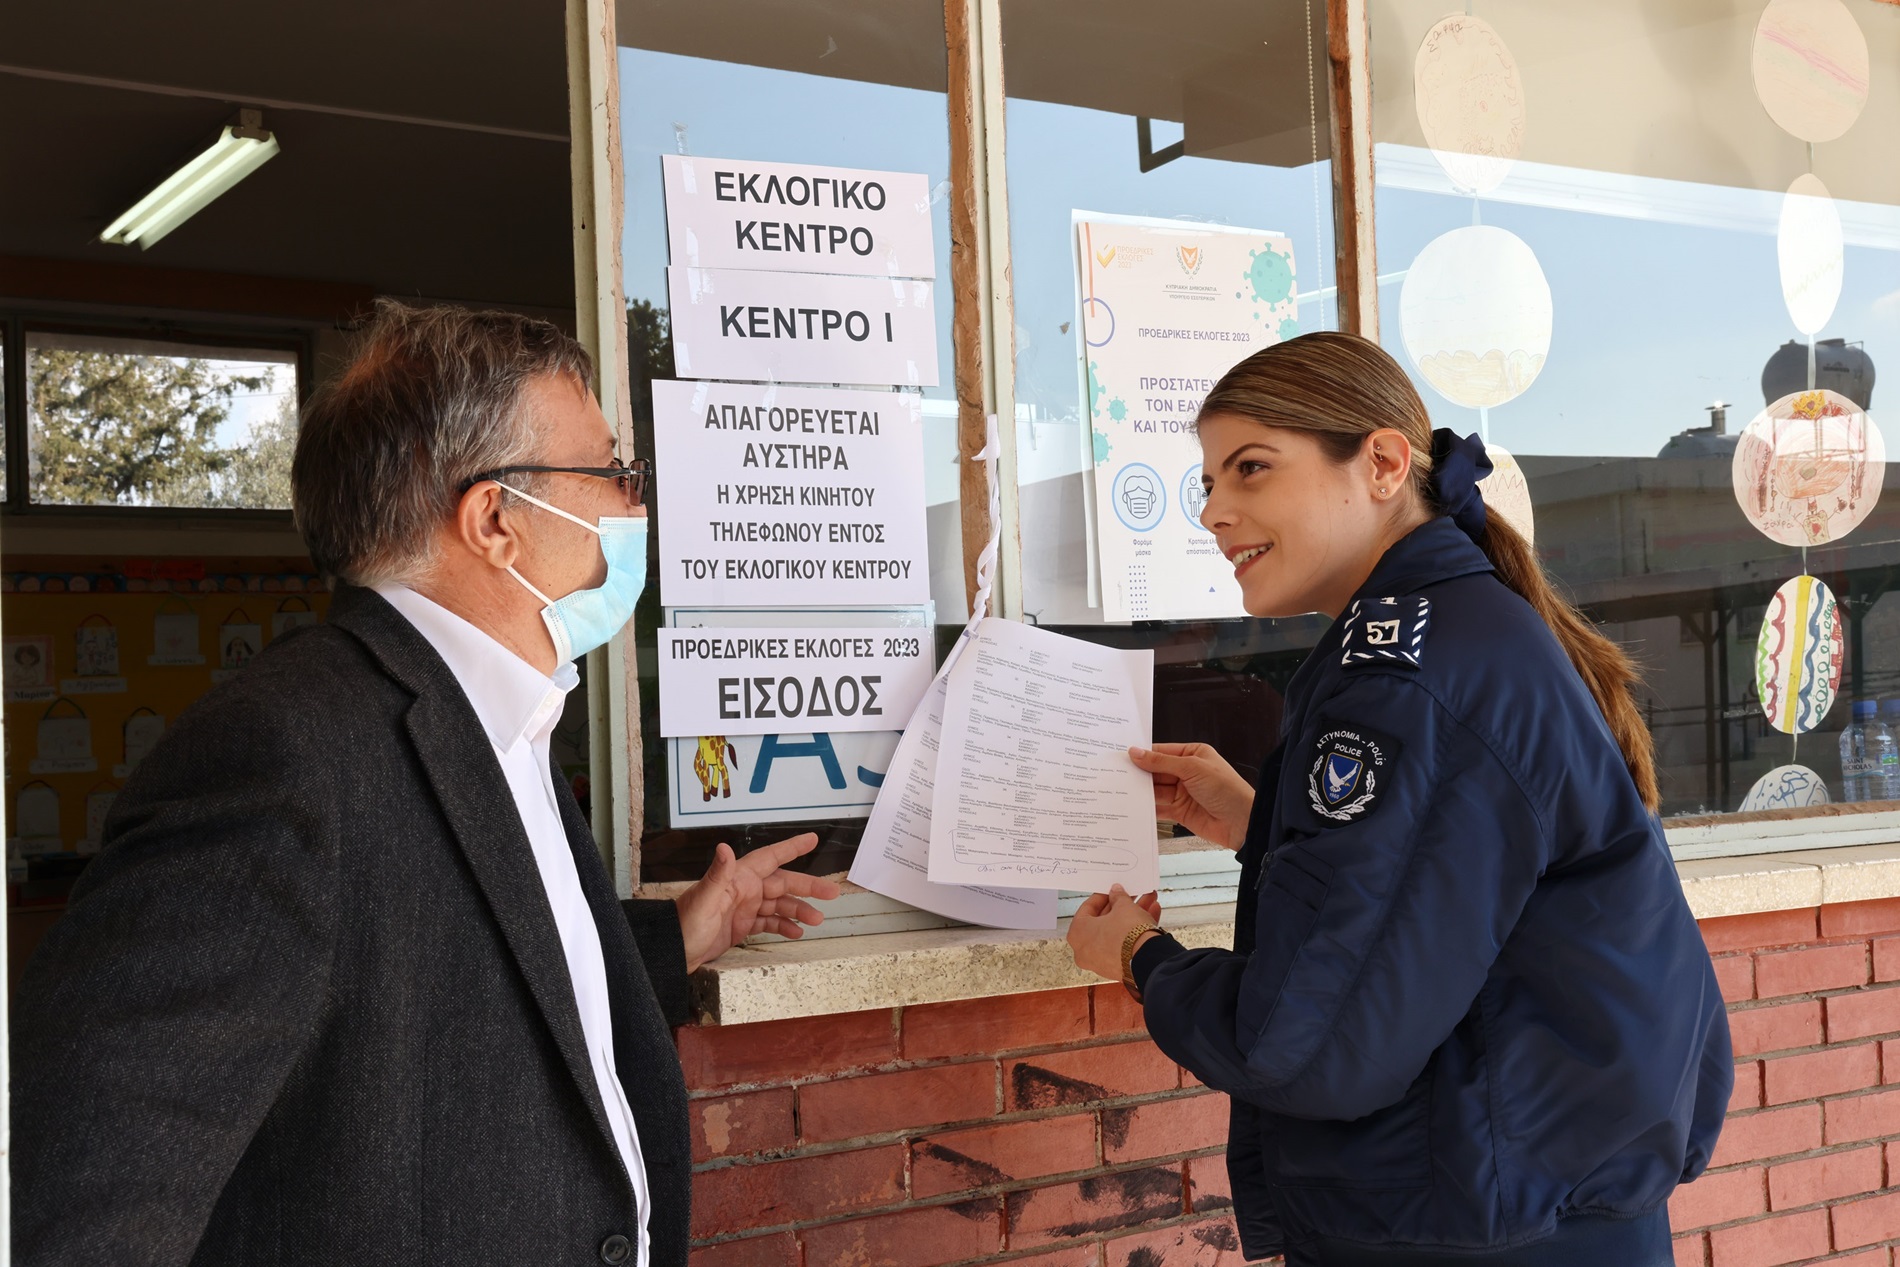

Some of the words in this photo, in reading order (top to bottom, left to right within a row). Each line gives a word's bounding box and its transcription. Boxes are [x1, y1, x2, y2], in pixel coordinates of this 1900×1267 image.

[715, 171, 886, 211] ΕΚΛΟΓΙΚΟ
[735, 220, 874, 256] ΚΕΝΤΡΟ
[1117, 246, 1154, 256] ΠΡΟΕΔΡΙΚΕΣ
[1118, 254, 1144, 263] ΕΚΛΟΓΕΣ
[720, 305, 870, 342] ΚΕΝΤΡΟ
[1138, 327, 1191, 340] ΠΡΟΕΔΡΙΚΕΣ
[1194, 330, 1230, 341] ΕΚΛΟΓΕΣ
[1232, 332, 1250, 342] 2023
[1140, 377, 1218, 392] ΠΡΟΣΤΑΤΕΥ
[1145, 398, 1173, 412] ΤΟΝ
[1178, 399, 1203, 412] ΕΑΥ
[704, 404, 879, 436] ΑΠΑΓΟΡΕΥΕΤΑΙ
[1133, 420, 1157, 433] ΚΑΙ
[742, 443, 849, 470] ΑΥΣΤΗΡΑ
[717, 484, 729, 504] Η
[735, 484, 794, 506] ΧΡΗΣΗ
[800, 486, 875, 507] ΚΙΝΗΤΟΥ
[709, 522, 822, 543] ΤΗΛΕΦΩΝΟΥ
[828, 523, 885, 543] ΕΝΤΟΣ
[681, 559, 719, 580] ΤΟΥ
[725, 559, 827, 580] ΕΚΛΟΓΙΚΟΥ
[832, 559, 912, 580] ΚΕΝΤΡΟΥ
[1366, 619, 1400, 645] 57
[671, 638, 789, 660] ΠΡΟΕΔΡΙΚΕΣ
[794, 638, 874, 659] ΕΚΛΟΓΕΣ
[883, 637, 920, 658] 2023
[718, 675, 883, 720] ΕΙΣΟΔΟΣ
[1316, 730, 1360, 749] ΑΣΤΥΝΟΜΙΑ
[1334, 743, 1363, 757] POLICE
